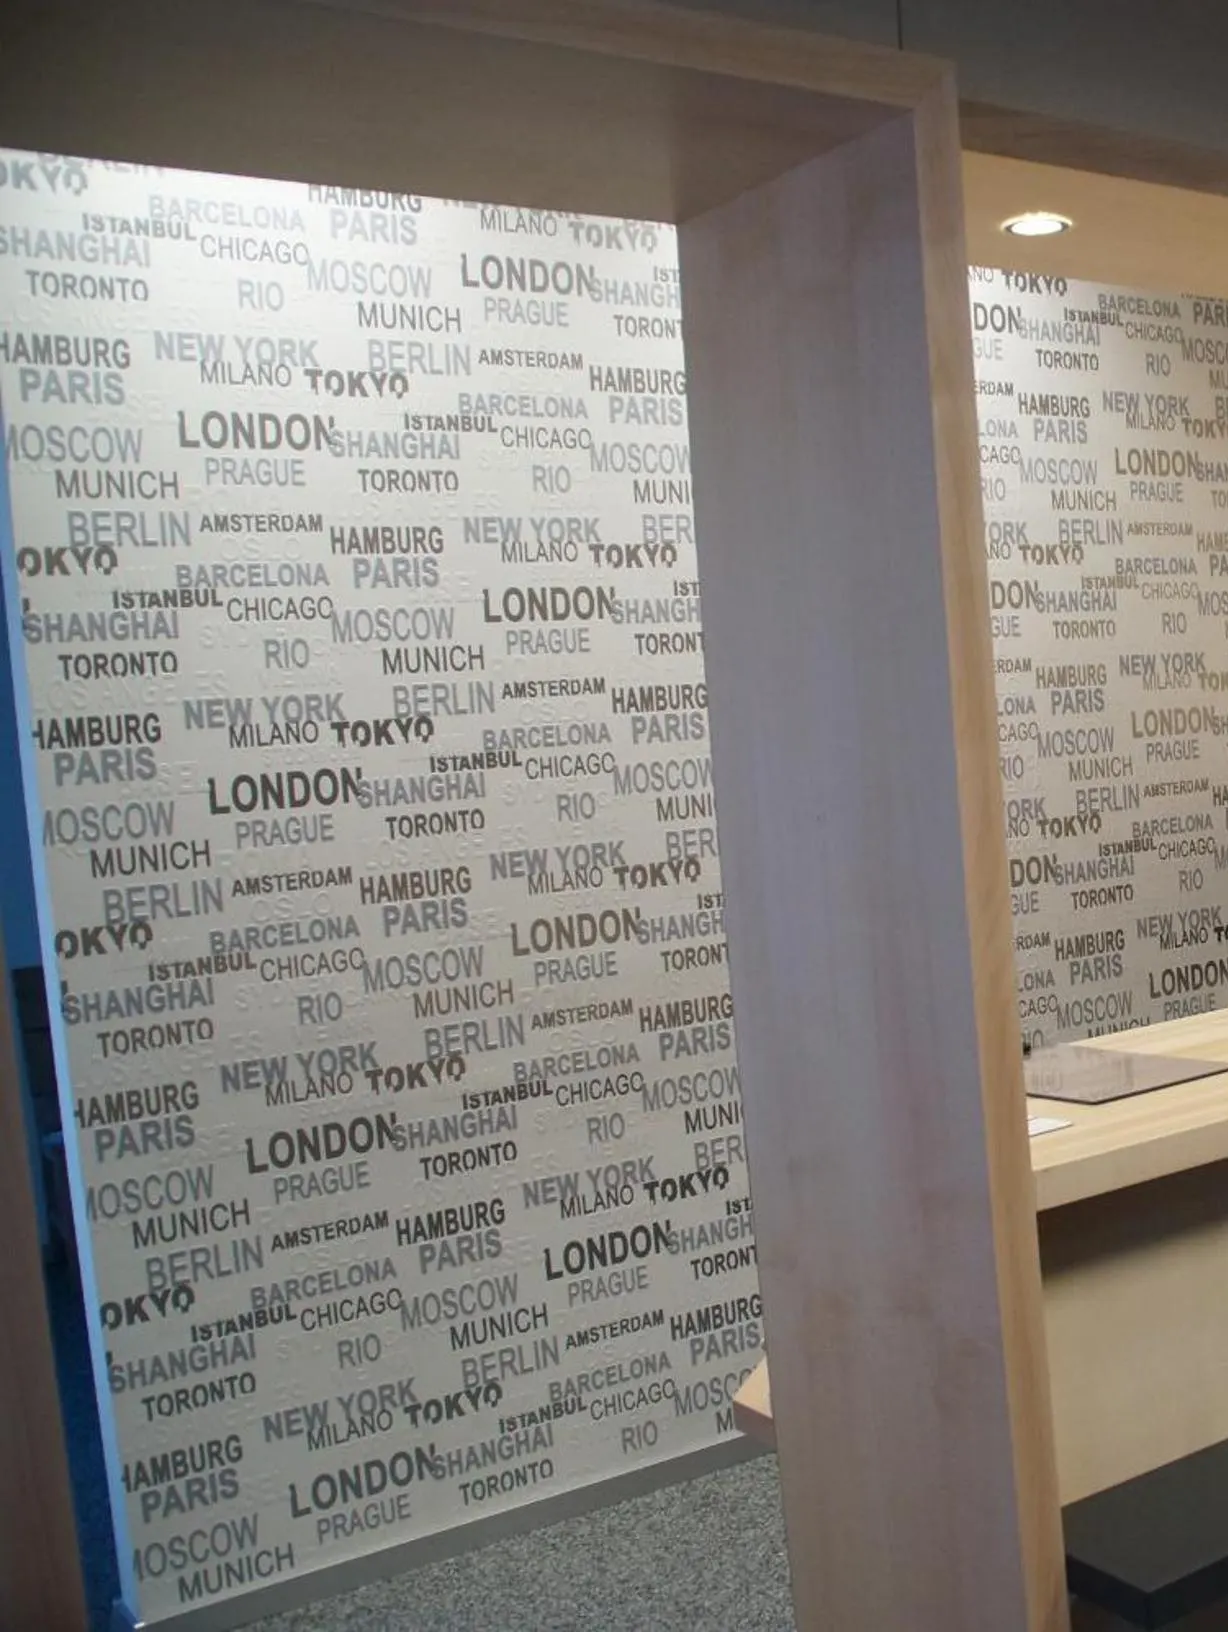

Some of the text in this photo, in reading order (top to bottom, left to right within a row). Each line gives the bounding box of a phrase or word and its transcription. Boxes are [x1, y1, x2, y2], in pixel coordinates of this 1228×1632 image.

[308, 258, 432, 299] MOSCOW
[1001, 270, 1067, 297] TOKYO
[1064, 307, 1123, 327] ISTANBUL
[1097, 293, 1182, 319] BARCELONA
[154, 330, 319, 368] NEW YORK
[1018, 319, 1100, 347] SHANGHAI
[1125, 322, 1183, 345] CHICAGO
[1035, 349, 1099, 371] TORONTO
[1146, 353, 1171, 376] RIO
[1018, 392, 1091, 418] HAMBURG
[1102, 390, 1190, 416] NEW YORK
[1034, 418, 1087, 445] PARIS
[1126, 411, 1175, 432] MILANO
[1020, 458, 1098, 486] MOSCOW
[1115, 447, 1199, 478] LONDON
[1051, 489, 1117, 512] MUNICH
[1130, 480, 1183, 503] PRAGUE
[464, 516, 600, 545] NEW YORK
[1058, 518, 1124, 546] BERLIN
[1127, 522, 1193, 537] AMSTERDAM
[17, 543, 118, 577] OKYO
[1018, 543, 1085, 566] TOKYO
[1115, 558, 1197, 576] BARCELONA
[112, 589, 223, 610] ISTANBUL
[1081, 575, 1139, 591] ISTANBUL
[1142, 582, 1199, 601] CHICAGO
[227, 596, 333, 622] CHICAGO
[483, 586, 615, 623] LONDON
[611, 600, 701, 625] SHANGH
[1036, 589, 1117, 614] SHANGHAI
[331, 607, 455, 643] MOSCOW
[1053, 619, 1116, 640] TORONTO
[1162, 612, 1187, 635] RIO
[58, 650, 178, 681] TORONTO
[382, 644, 485, 676] MUNICH
[1036, 663, 1107, 690] HAMBURG
[1119, 652, 1206, 677] NEW YORK
[502, 677, 606, 701] AMSTERDAM
[612, 683, 709, 714] HAMBURG
[1142, 671, 1192, 692] MILANO
[183, 692, 346, 730] NEW YORK
[1051, 688, 1104, 716] PARIS
[229, 719, 319, 749] MILANO
[330, 715, 434, 749] TOKYO
[1131, 705, 1215, 739] LONDON
[1037, 727, 1115, 759] MOSCOW
[1146, 740, 1199, 763] PRAGUE
[430, 751, 523, 774] ISTANBUL
[525, 752, 616, 780] CHICAGO
[1068, 754, 1133, 782] MUNICH
[207, 767, 363, 815] LONDON
[1076, 783, 1140, 815] BERLIN
[1143, 778, 1209, 798] AMSTERDAM
[386, 808, 485, 841] TORONTO
[1036, 812, 1102, 840] TOKYO
[1132, 814, 1213, 838] BARCELONA
[90, 838, 211, 880] MUNICH
[490, 848, 548, 881] NEW
[555, 840, 626, 869] YORK
[1099, 838, 1157, 857] ISTANBUL
[1158, 837, 1215, 861] CHICAGO
[231, 865, 353, 898] AMSTERDAM
[359, 865, 472, 906] HAMBURG
[612, 858, 701, 891] TOKYO
[1052, 856, 1135, 887] SHANGHAI
[1179, 867, 1204, 893] RIO
[102, 876, 224, 925] BERLIN
[1071, 884, 1134, 911] TORONTO
[210, 914, 361, 956] BARCELONA
[1136, 905, 1222, 939] NEW YORK
[1054, 928, 1125, 962] HAMBURG
[1159, 927, 1208, 952] MILANO
[364, 945, 484, 993] MOSCOW
[534, 951, 619, 988] PRAGUE
[1069, 954, 1123, 986] PARIS
[62, 978, 215, 1026] SHANGHAI
[297, 992, 343, 1025] RIO
[639, 993, 734, 1033] HAMBURG
[1057, 990, 1133, 1030] MOSCOW
[1164, 993, 1216, 1021] PRAGUE
[424, 1013, 525, 1062] BERLIN
[220, 1041, 380, 1095] NEW YORK
[365, 1053, 466, 1096] TOKYO
[513, 1042, 640, 1083] BARCELONA
[265, 1071, 353, 1108] MILANO
[462, 1079, 553, 1111] ISTANBUL
[555, 1071, 645, 1108] CHICAGO
[95, 1115, 194, 1163] PARIS
[246, 1112, 398, 1174] LONDON
[392, 1106, 518, 1152] SHANGHAI
[586, 1112, 626, 1145] RIO
[420, 1140, 518, 1181] TORONTO
[274, 1160, 371, 1205] PRAGUE
[522, 1155, 657, 1209] NEW YORK
[643, 1166, 730, 1205] TOKYO
[560, 1184, 634, 1221] MILANO
[132, 1199, 251, 1250] MUNICH
[271, 1210, 389, 1253] AMSTERDAM
[396, 1198, 506, 1248] HAMBURG
[145, 1235, 264, 1295] BERLIN
[418, 1227, 502, 1276] PARIS
[544, 1219, 673, 1282] LONDON
[251, 1257, 397, 1311] BARCELONA
[568, 1264, 650, 1309] PRAGUE
[100, 1281, 195, 1331] OKYO
[300, 1287, 403, 1332] CHICAGO
[402, 1272, 518, 1333] MOSCOW
[670, 1293, 763, 1342] HAMBURG
[190, 1303, 297, 1344] ISTANBUL
[450, 1303, 549, 1352] MUNICH
[566, 1308, 665, 1351] AMSTERDAM
[337, 1333, 382, 1370] RIO
[690, 1321, 761, 1367] PARIS
[108, 1333, 257, 1394] SHANGHAI
[461, 1334, 560, 1392] BERLIN
[549, 1351, 672, 1402] BARCELONA
[141, 1372, 256, 1422] TORONTO
[263, 1376, 418, 1443] NEW YORK
[403, 1380, 503, 1429] TOKYO
[307, 1408, 394, 1453] MILANO
[499, 1395, 588, 1435] ISTANBUL
[431, 1424, 554, 1481] SHANGHAI
[621, 1420, 659, 1454] RIO
[140, 1468, 240, 1525] PARIS
[289, 1443, 439, 1519] LONDON
[316, 1493, 412, 1545] PRAGUE
